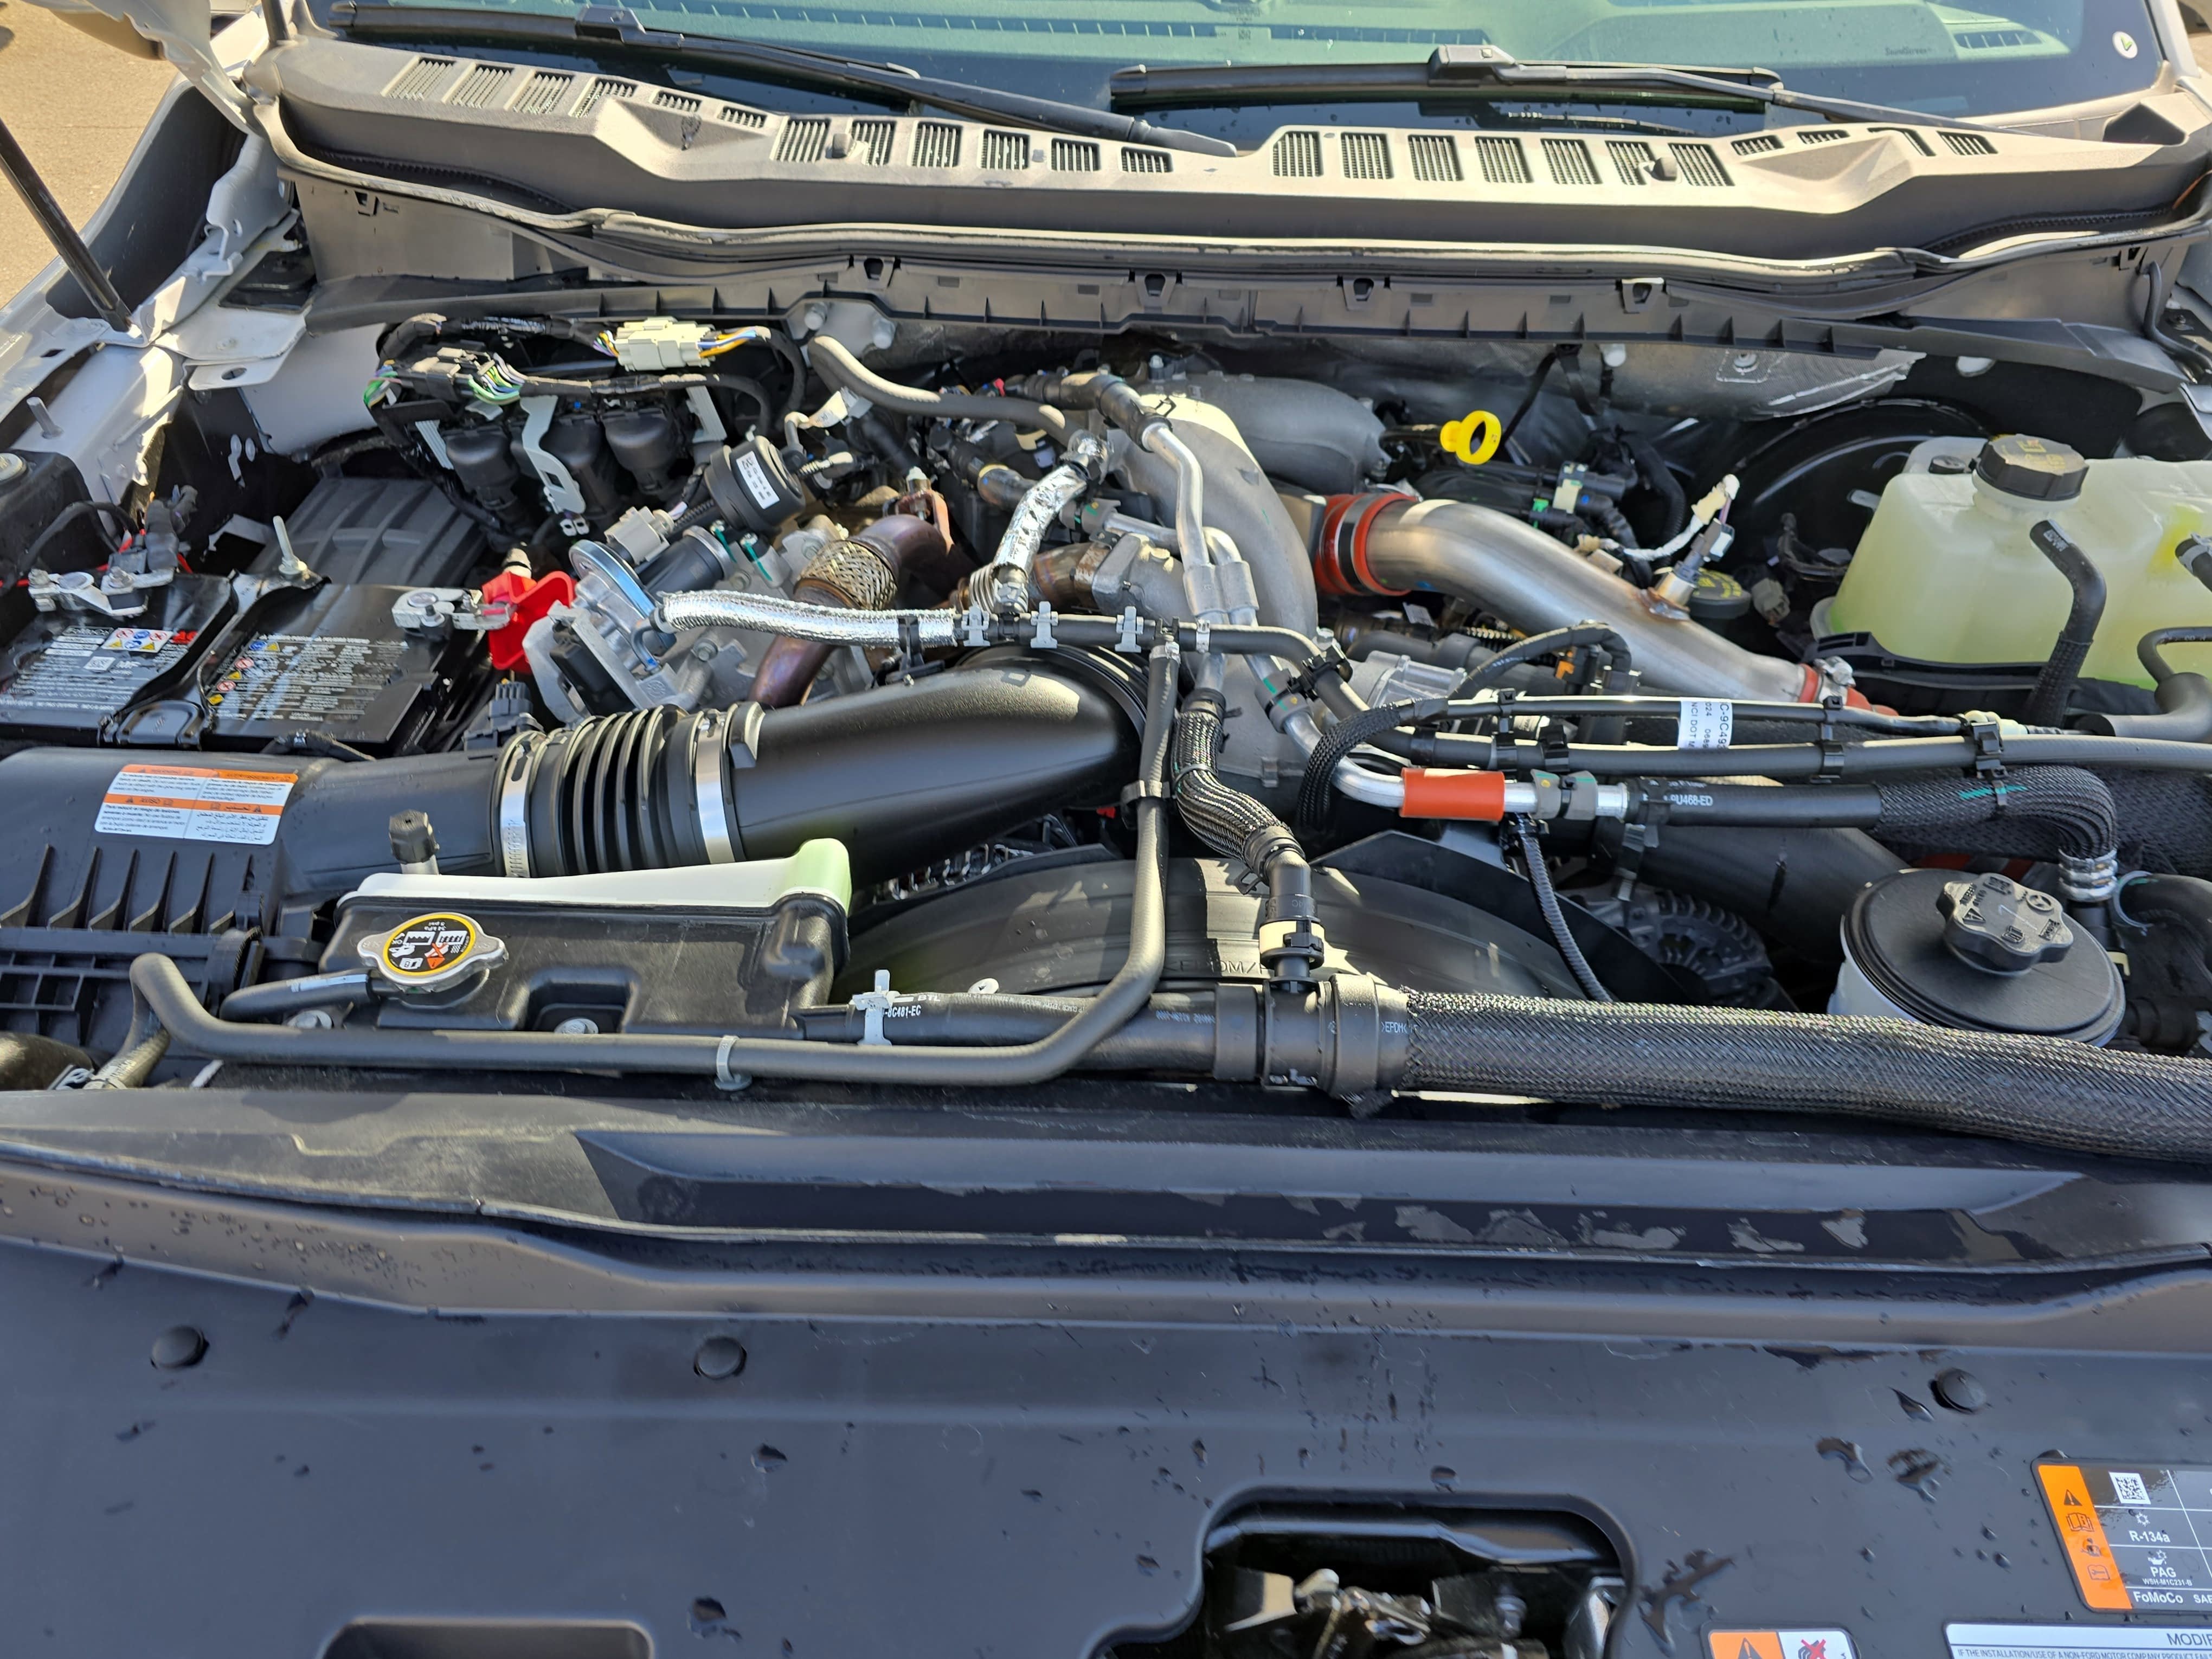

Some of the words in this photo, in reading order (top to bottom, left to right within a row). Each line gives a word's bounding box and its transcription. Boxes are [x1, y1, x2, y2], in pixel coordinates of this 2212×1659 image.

[2129, 1530, 2170, 1543] R-134a
[2150, 1566, 2176, 1578] PAG
[2133, 1591, 2184, 1604] FoMoCo
[1958, 1649, 1965, 1657] IF
[1966, 1649, 1978, 1658] THE
[1980, 1649, 2048, 1659] INSTALLATION/USE
[2048, 1650, 2057, 1659] OF
[2058, 1651, 2064, 1659] A
[2065, 1651, 2100, 1659] NON-FORD
